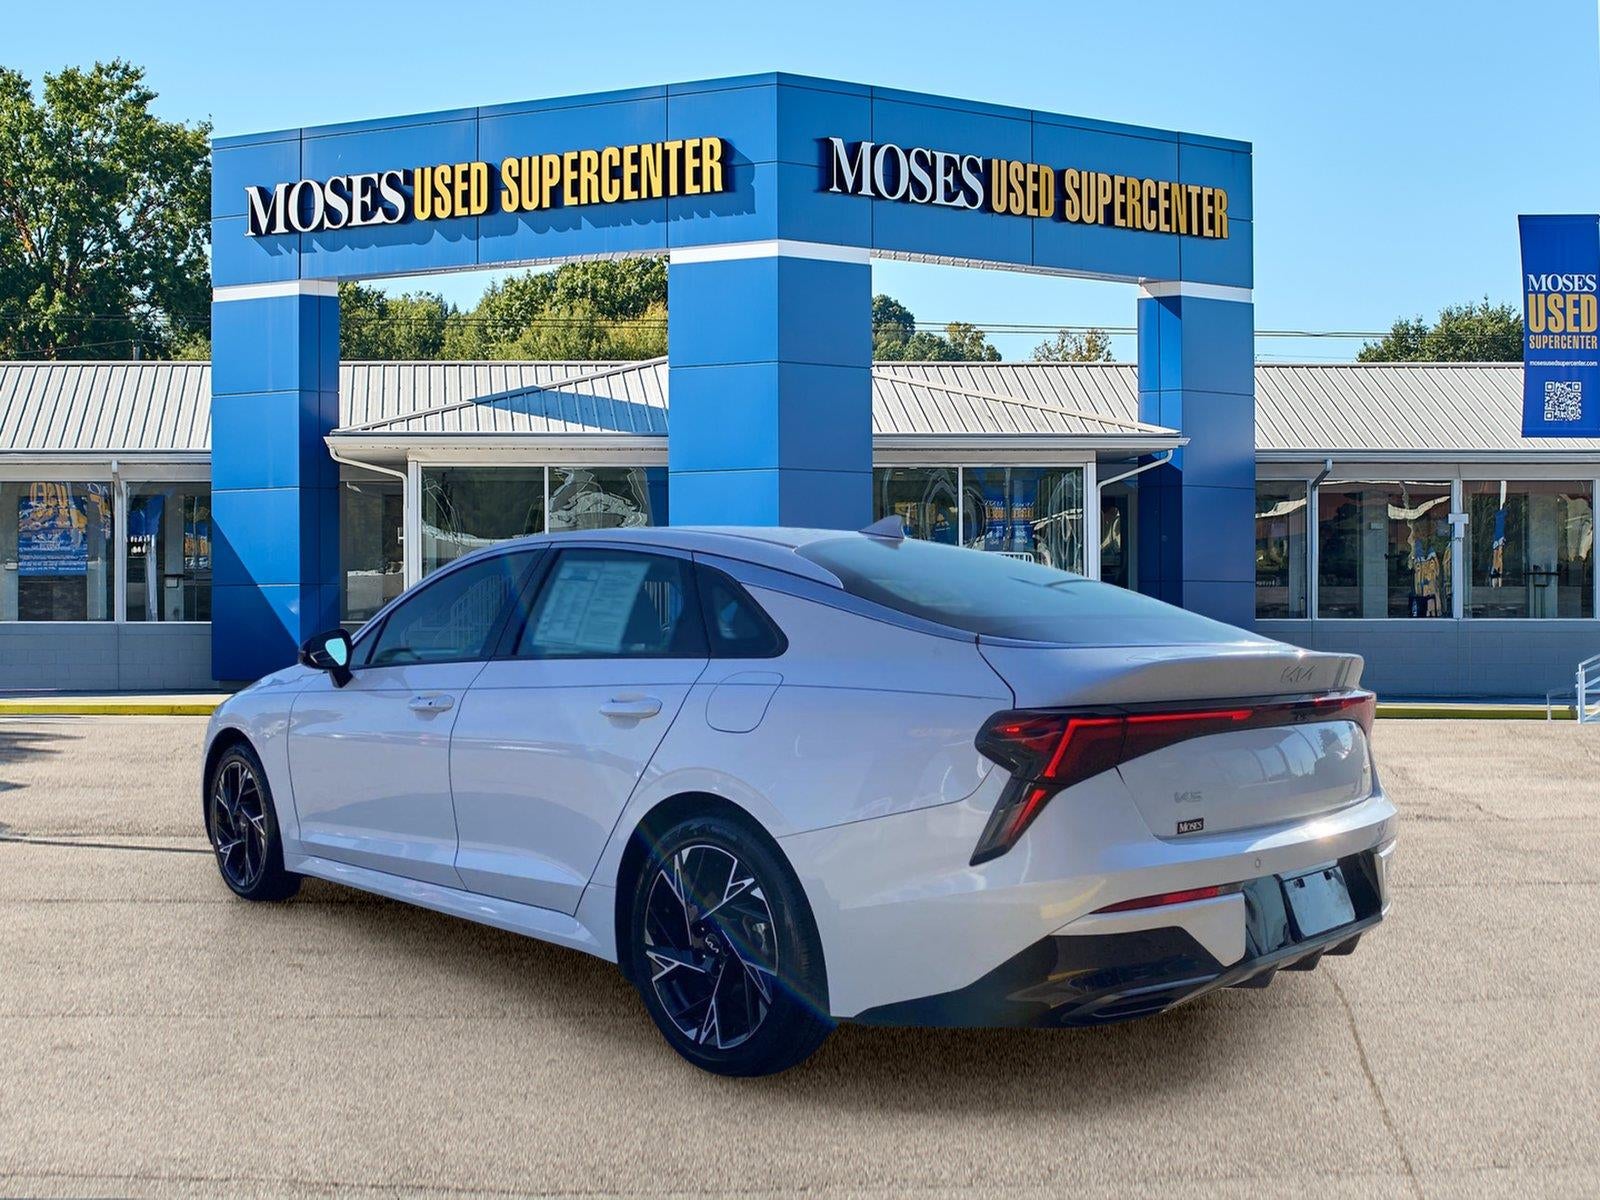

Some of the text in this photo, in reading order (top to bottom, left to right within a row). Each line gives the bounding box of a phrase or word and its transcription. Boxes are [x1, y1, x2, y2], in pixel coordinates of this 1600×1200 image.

[244, 136, 724, 237] MOSES USED SUPERCENTER
[829, 136, 1229, 240] MOSES USED SUPERCENTER
[1527, 273, 1597, 292] MOSES
[1528, 293, 1598, 333] USED
[1529, 334, 1598, 350] SUPERCENTER
[1529, 360, 1598, 368] mosesusedsupercenter.com
